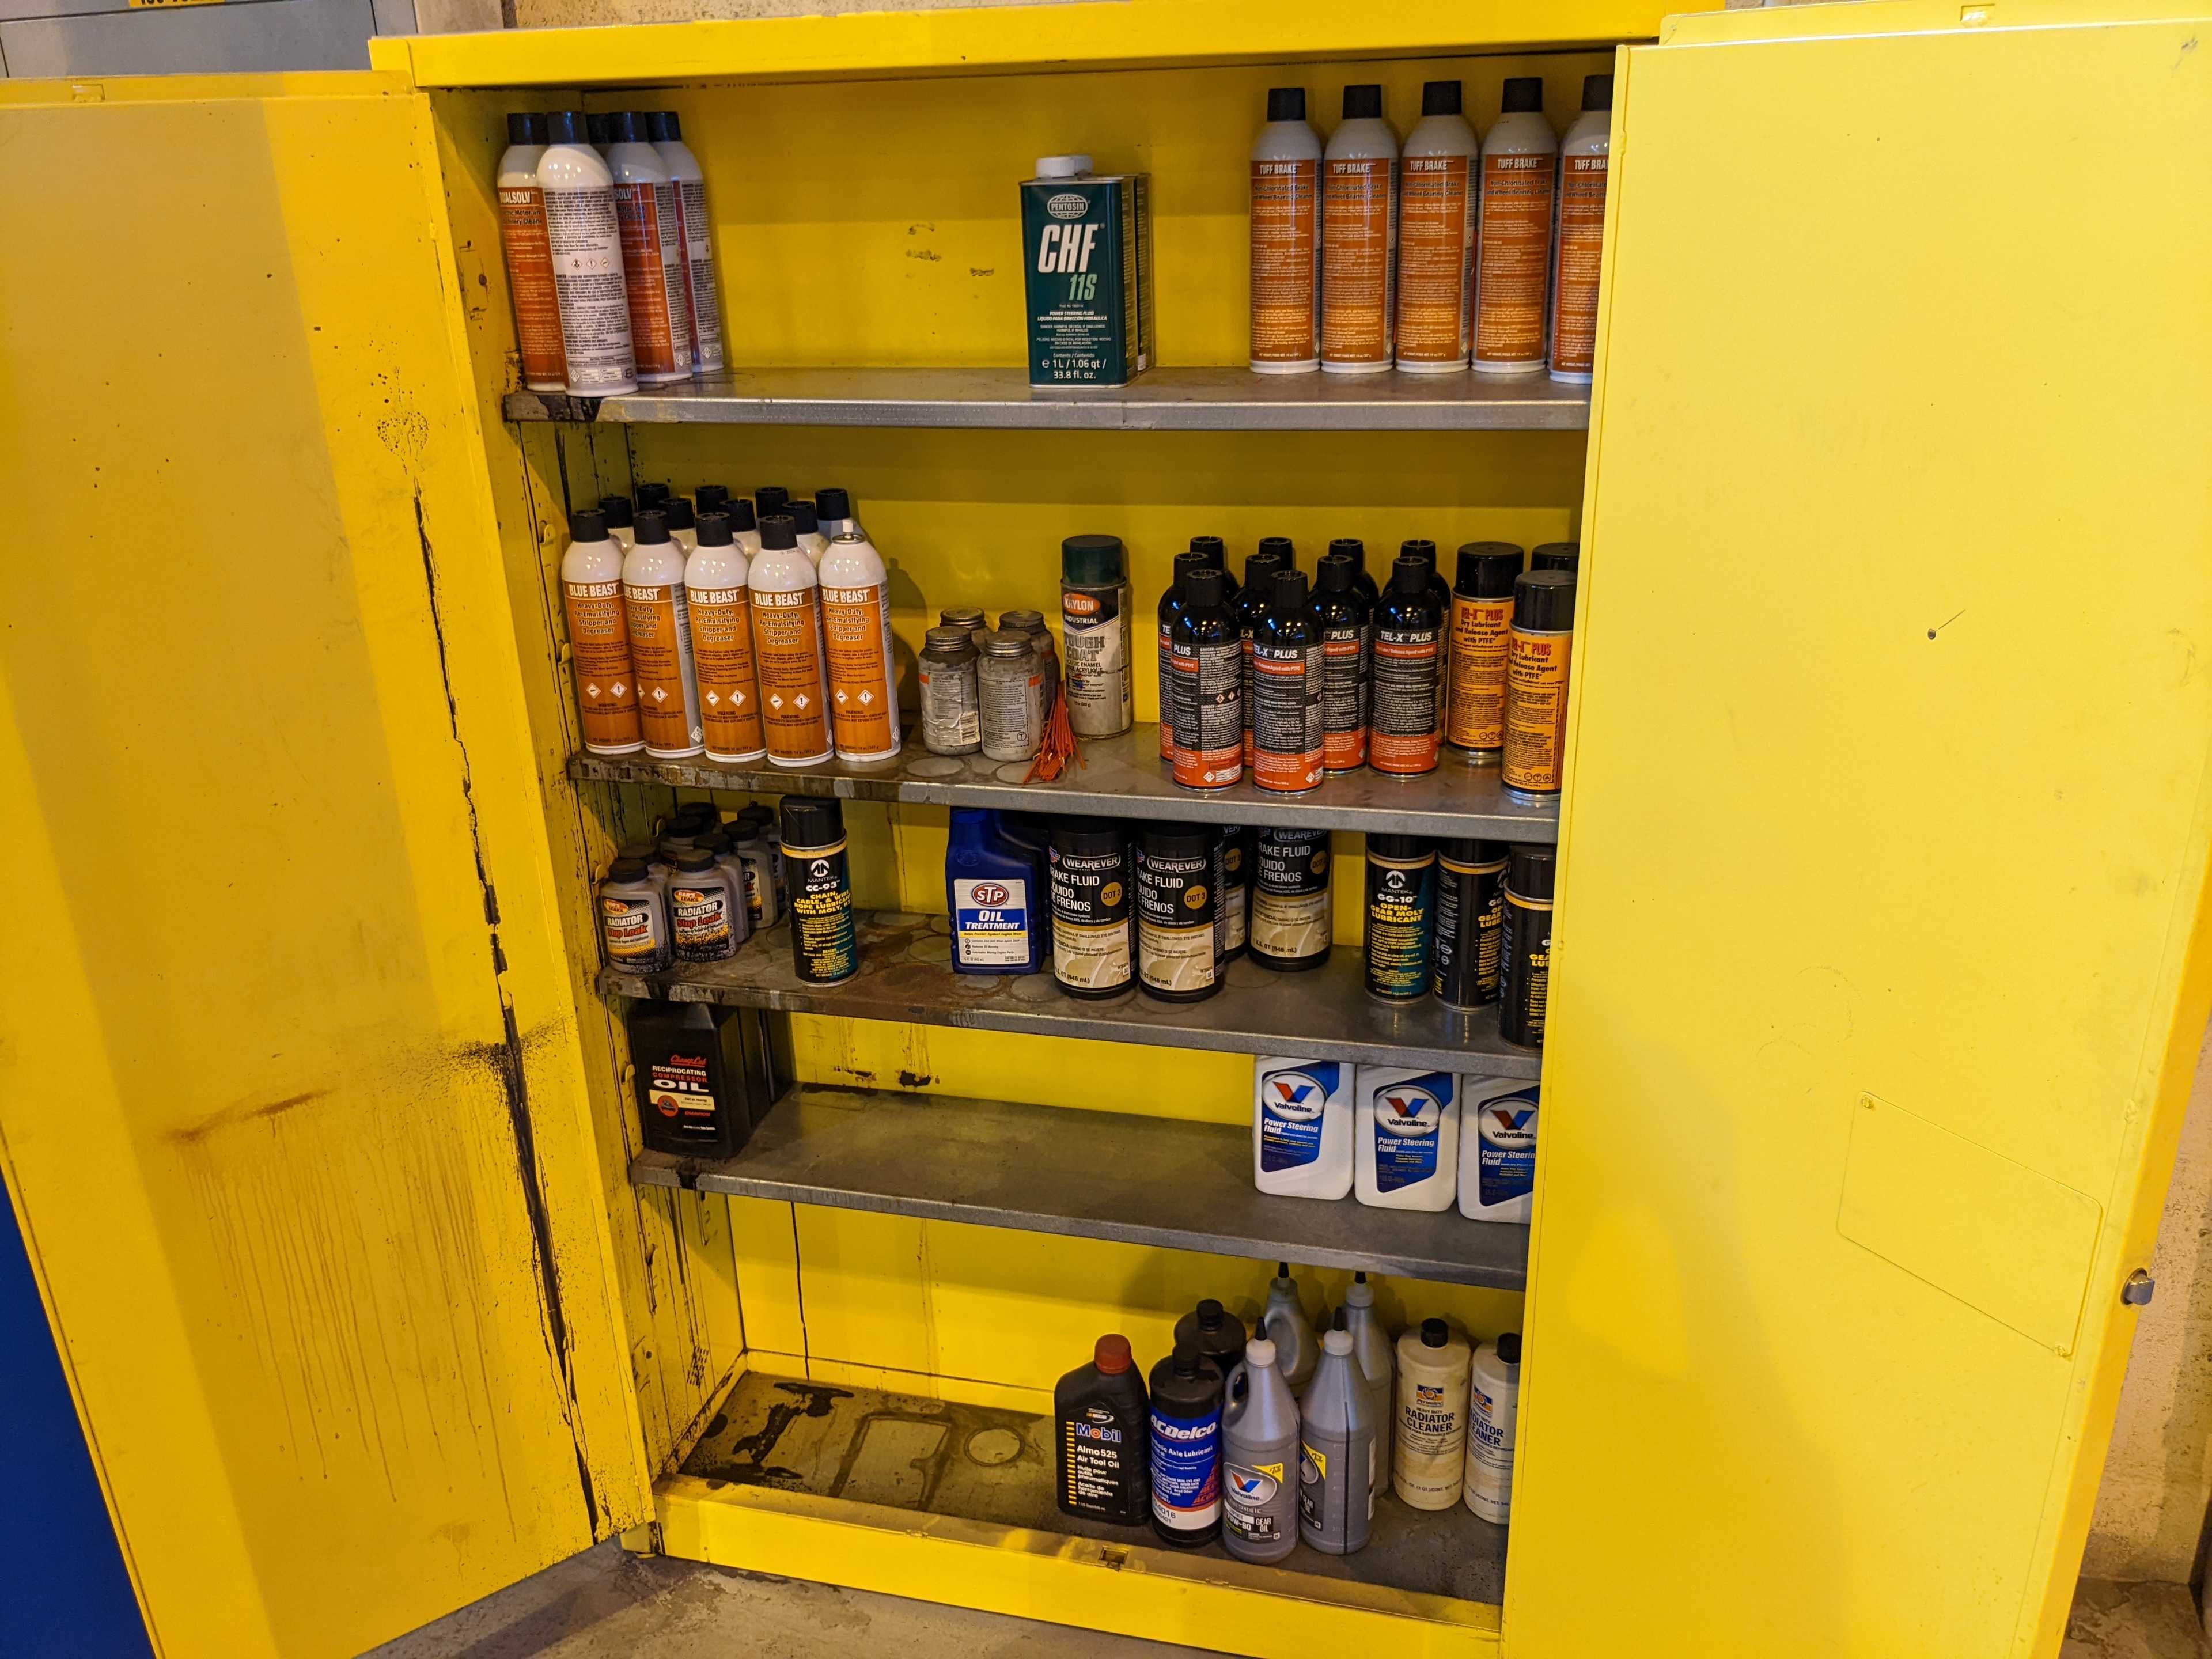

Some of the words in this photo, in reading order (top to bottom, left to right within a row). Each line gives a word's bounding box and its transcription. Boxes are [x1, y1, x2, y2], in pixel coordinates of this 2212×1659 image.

[1259, 165, 1273, 175] TUFF
[1274, 164, 1297, 175] BRAKE
[1332, 164, 1346, 174] TUFF
[1347, 164, 1370, 174] BRAKE
[1410, 161, 1423, 171] TUFF
[1425, 160, 1447, 171] BRAKE
[1498, 158, 1513, 169] TUFF
[1514, 158, 1537, 169] BRAKE
[1575, 160, 1590, 171] TUFF
[1591, 159, 1608, 171] BRA
[1051, 203, 1084, 211] PENTOSIN
[1037, 224, 1099, 273] CHF
[1069, 274, 1097, 301] 11S
[1072, 359, 1089, 368] 1.06
[1054, 371, 1071, 379] 33.8
[569, 584, 589, 597] BLUE
[589, 583, 618, 597] BEAST
[633, 588, 660, 601] BEAST
[822, 589, 839, 603] BLUE
[840, 589, 869, 603] BEAST
[690, 590, 709, 604] BLUE
[709, 589, 738, 603] BEAST
[754, 593, 774, 607] BLUE
[774, 592, 804, 607] BEAST
[1065, 597, 1094, 611] KRYLON
[1065, 615, 1098, 624] INDUSTRIAL
[1485, 608, 1503, 621] PLUS
[830, 624, 853, 632] Stripper
[1490, 629, 1508, 637] Agent
[1331, 630, 1354, 640] PLUS
[1381, 631, 1403, 642] TEL-X
[1410, 632, 1432, 642] PLUS
[1066, 649, 1097, 661] COAT
[1173, 644, 1191, 656] PLUS
[1274, 650, 1297, 659] PLUS
[1532, 643, 1551, 656] PLUS
[1518, 654, 1548, 663] Lubricant
[1536, 664, 1557, 673] Agent
[1283, 846, 1311, 857] FLUID
[1066, 857, 1118, 870] WEAREVER
[1150, 858, 1203, 872] WEAREVER
[1071, 875, 1100, 886] FLUID
[1155, 876, 1183, 888] FLUID
[1263, 870, 1302, 882] FRENOS
[806, 881, 838, 892] CC-93
[810, 891, 838, 899] CHAIN,
[976, 887, 1004, 903] STP
[1103, 891, 1116, 900] DOT
[1187, 893, 1200, 903] DOT
[1377, 893, 1414, 903] GG-10
[677, 902, 718, 916] RADIATOR
[819, 905, 842, 914] MOLY,
[1056, 895, 1091, 912] FRENOS
[1141, 896, 1174, 914] FRENOS
[1380, 903, 1412, 911] OPEN-
[978, 910, 1005, 922] OIL
[1370, 904, 1393, 916] GEAR
[1396, 908, 1424, 917] MOLY
[607, 915, 643, 927] RADIATOR
[698, 912, 722, 926] Leak
[1372, 911, 1422, 923] LUBRICANT
[624, 925, 648, 937] Leak
[652, 1065, 707, 1077] RECIPROCATING
[652, 1072, 707, 1082] COMPRESSOR
[653, 1079, 709, 1093] OIL
[1274, 1101, 1312, 1113] Valvoline
[1264, 1118, 1287, 1127] Power
[1287, 1122, 1319, 1133] Steering
[1387, 1118, 1427, 1127] Valvoline
[1264, 1124, 1282, 1134] Fluid
[1492, 1131, 1533, 1139] Valvoline
[1377, 1137, 1402, 1145] Power
[1402, 1138, 1435, 1147] Steering
[1377, 1144, 1396, 1153] Fluid
[1482, 1150, 1507, 1158] Power
[1482, 1157, 1501, 1165] Fluid
[1406, 1406, 1455, 1423] RADIATOR
[1150, 1414, 1217, 1440] ACDelco
[1407, 1416, 1452, 1433] CLEANER
[1076, 1422, 1122, 1443] Mobil
[1077, 1445, 1100, 1456] Almo
[1100, 1449, 1118, 1459] 525
[1168, 1447, 1183, 1457] Axle
[1184, 1445, 1213, 1457] Lubricant
[1077, 1455, 1089, 1463] Air
[1089, 1457, 1107, 1467] Tool
[1107, 1460, 1120, 1469] Oil
[1093, 1467, 1107, 1476] pour
[1077, 1474, 1119, 1486] pneumatiques
[1078, 1481, 1096, 1490] Aceite
[1078, 1486, 1113, 1497] herramienta
[1256, 1518, 1271, 1526] GEAR
[1259, 1524, 1269, 1532] OIL
